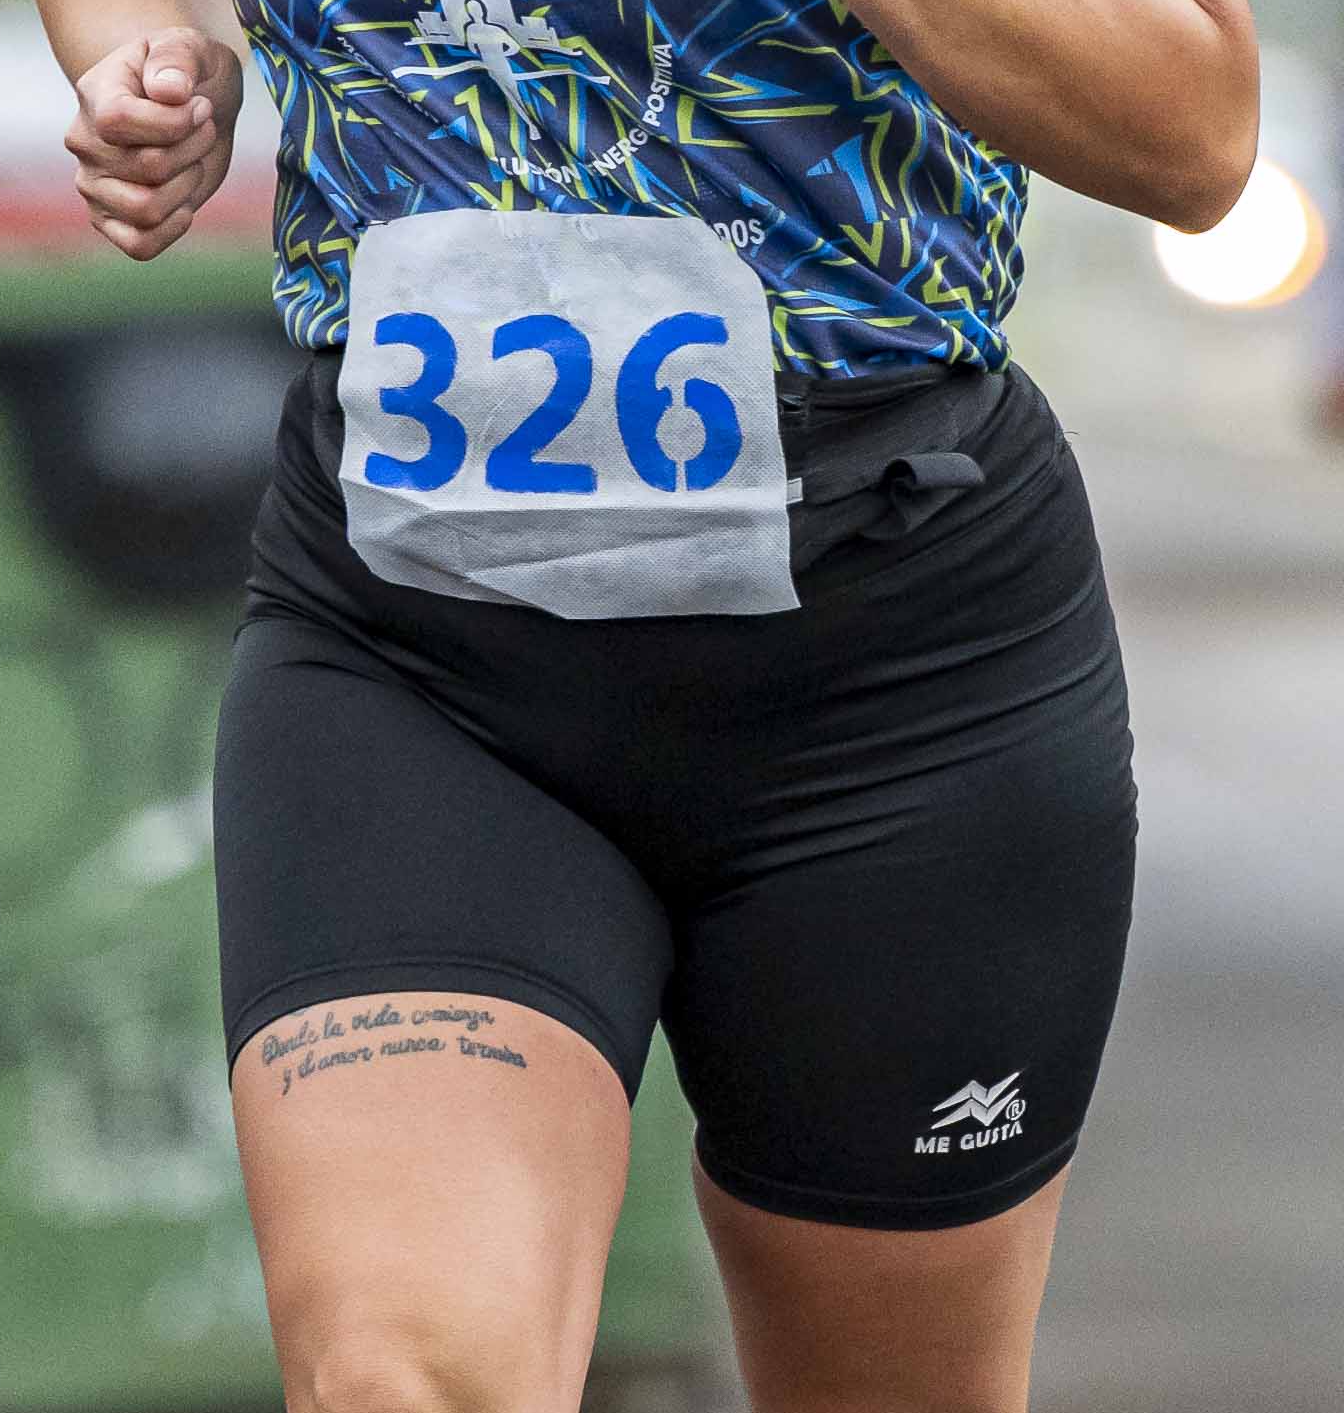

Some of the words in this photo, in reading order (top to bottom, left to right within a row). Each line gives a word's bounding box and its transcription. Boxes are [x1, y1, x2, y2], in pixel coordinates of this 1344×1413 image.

[364, 311, 744, 494] 326
[323, 1011, 347, 1039] la
[351, 1002, 406, 1031] vida
[281, 1068, 292, 1096] y
[317, 1045, 374, 1071] amor
[380, 1037, 447, 1059] nunca
[914, 1136, 951, 1154] ME
[960, 1120, 1024, 1150] GUSTA
